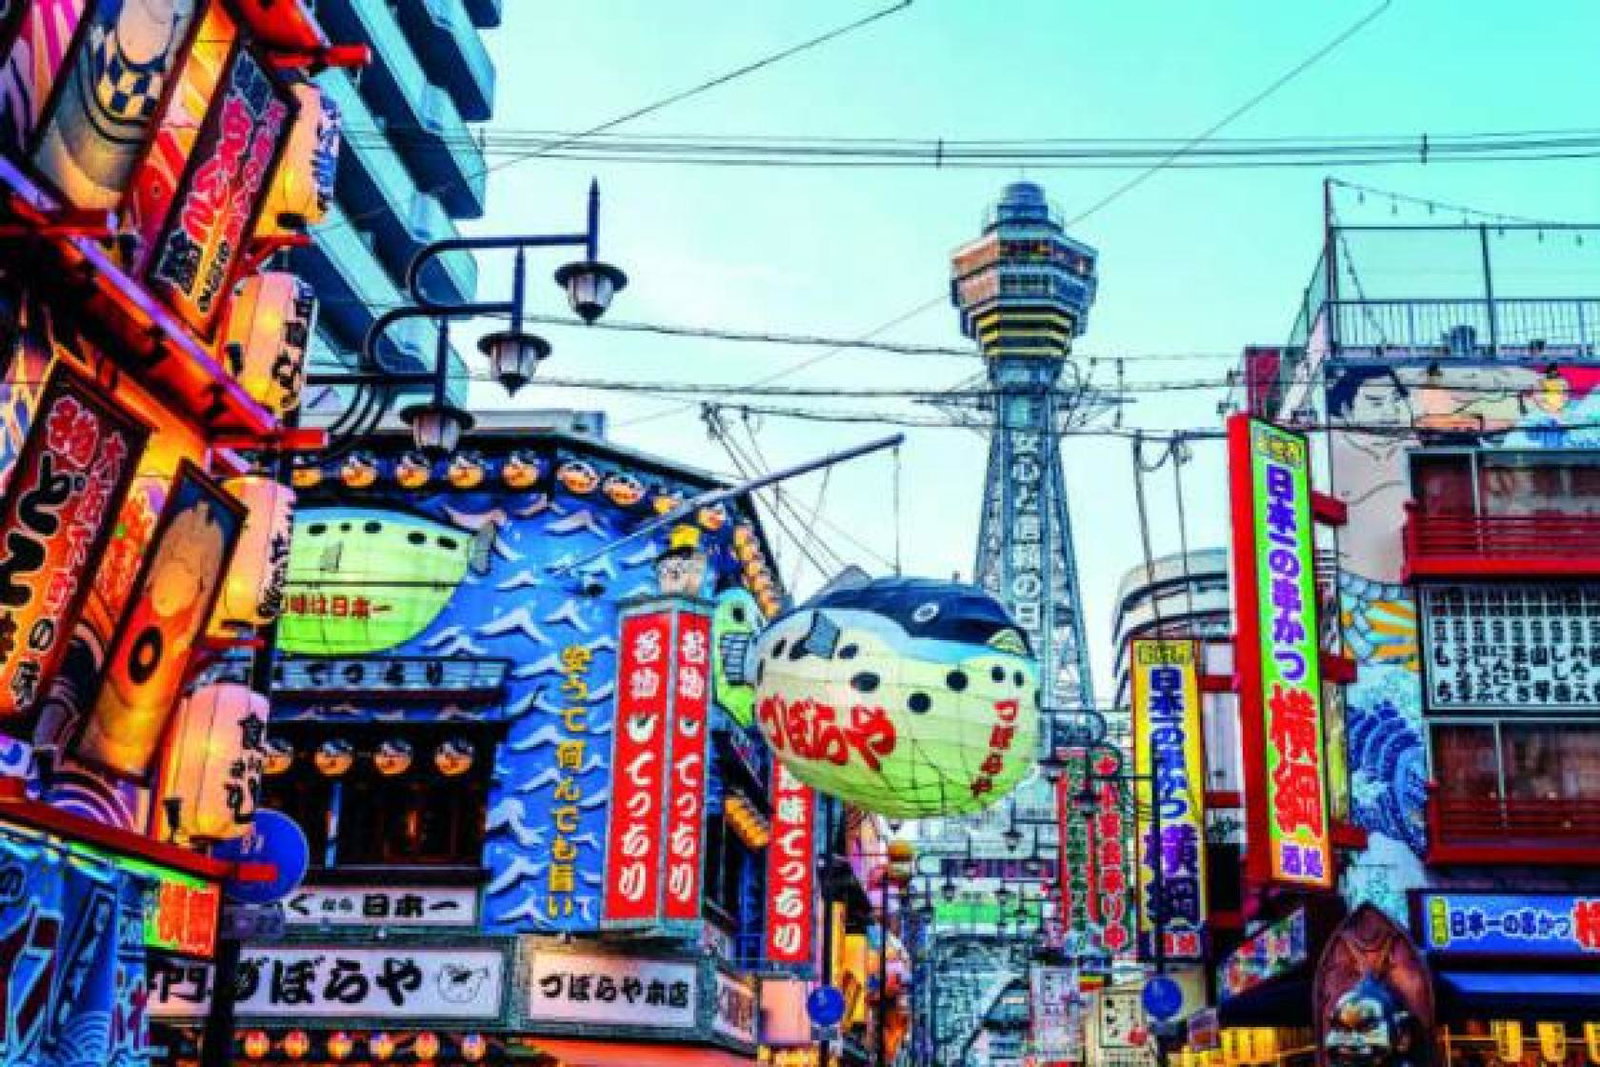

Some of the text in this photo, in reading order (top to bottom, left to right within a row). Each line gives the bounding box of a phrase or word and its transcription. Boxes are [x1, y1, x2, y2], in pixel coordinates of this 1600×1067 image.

[284, 593, 394, 619] 味は日本一
